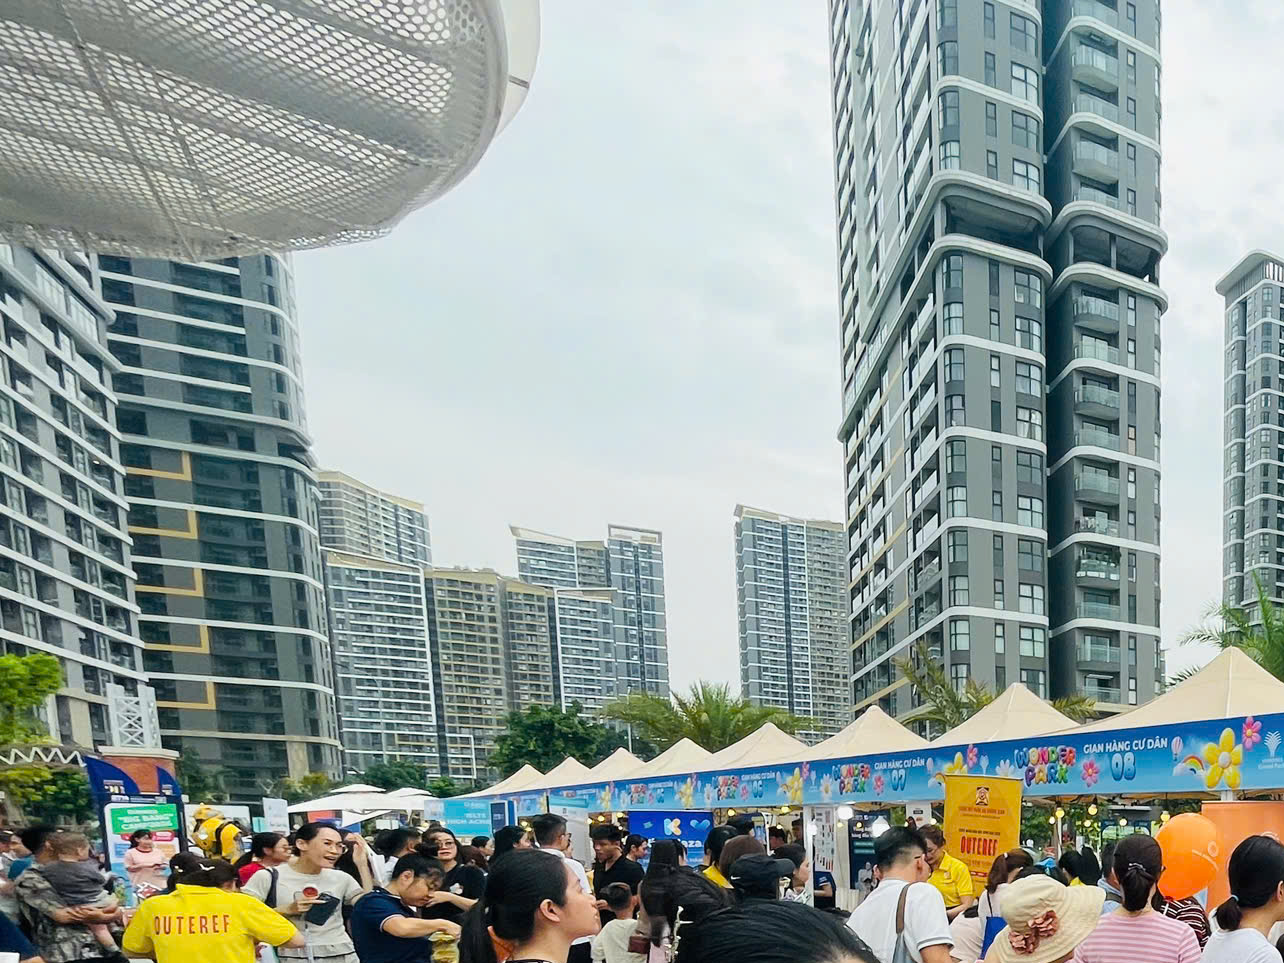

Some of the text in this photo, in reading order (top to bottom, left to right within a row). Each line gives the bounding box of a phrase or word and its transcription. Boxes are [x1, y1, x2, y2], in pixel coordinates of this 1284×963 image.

[1083, 736, 1168, 754] GIAN HÀNG CƯ DÂN
[1014, 745, 1076, 769] WONDER
[1111, 752, 1136, 781] 08
[1025, 764, 1069, 787] PARK
[961, 836, 998, 856] OUTEREF
[154, 914, 230, 935] OUTEREF
